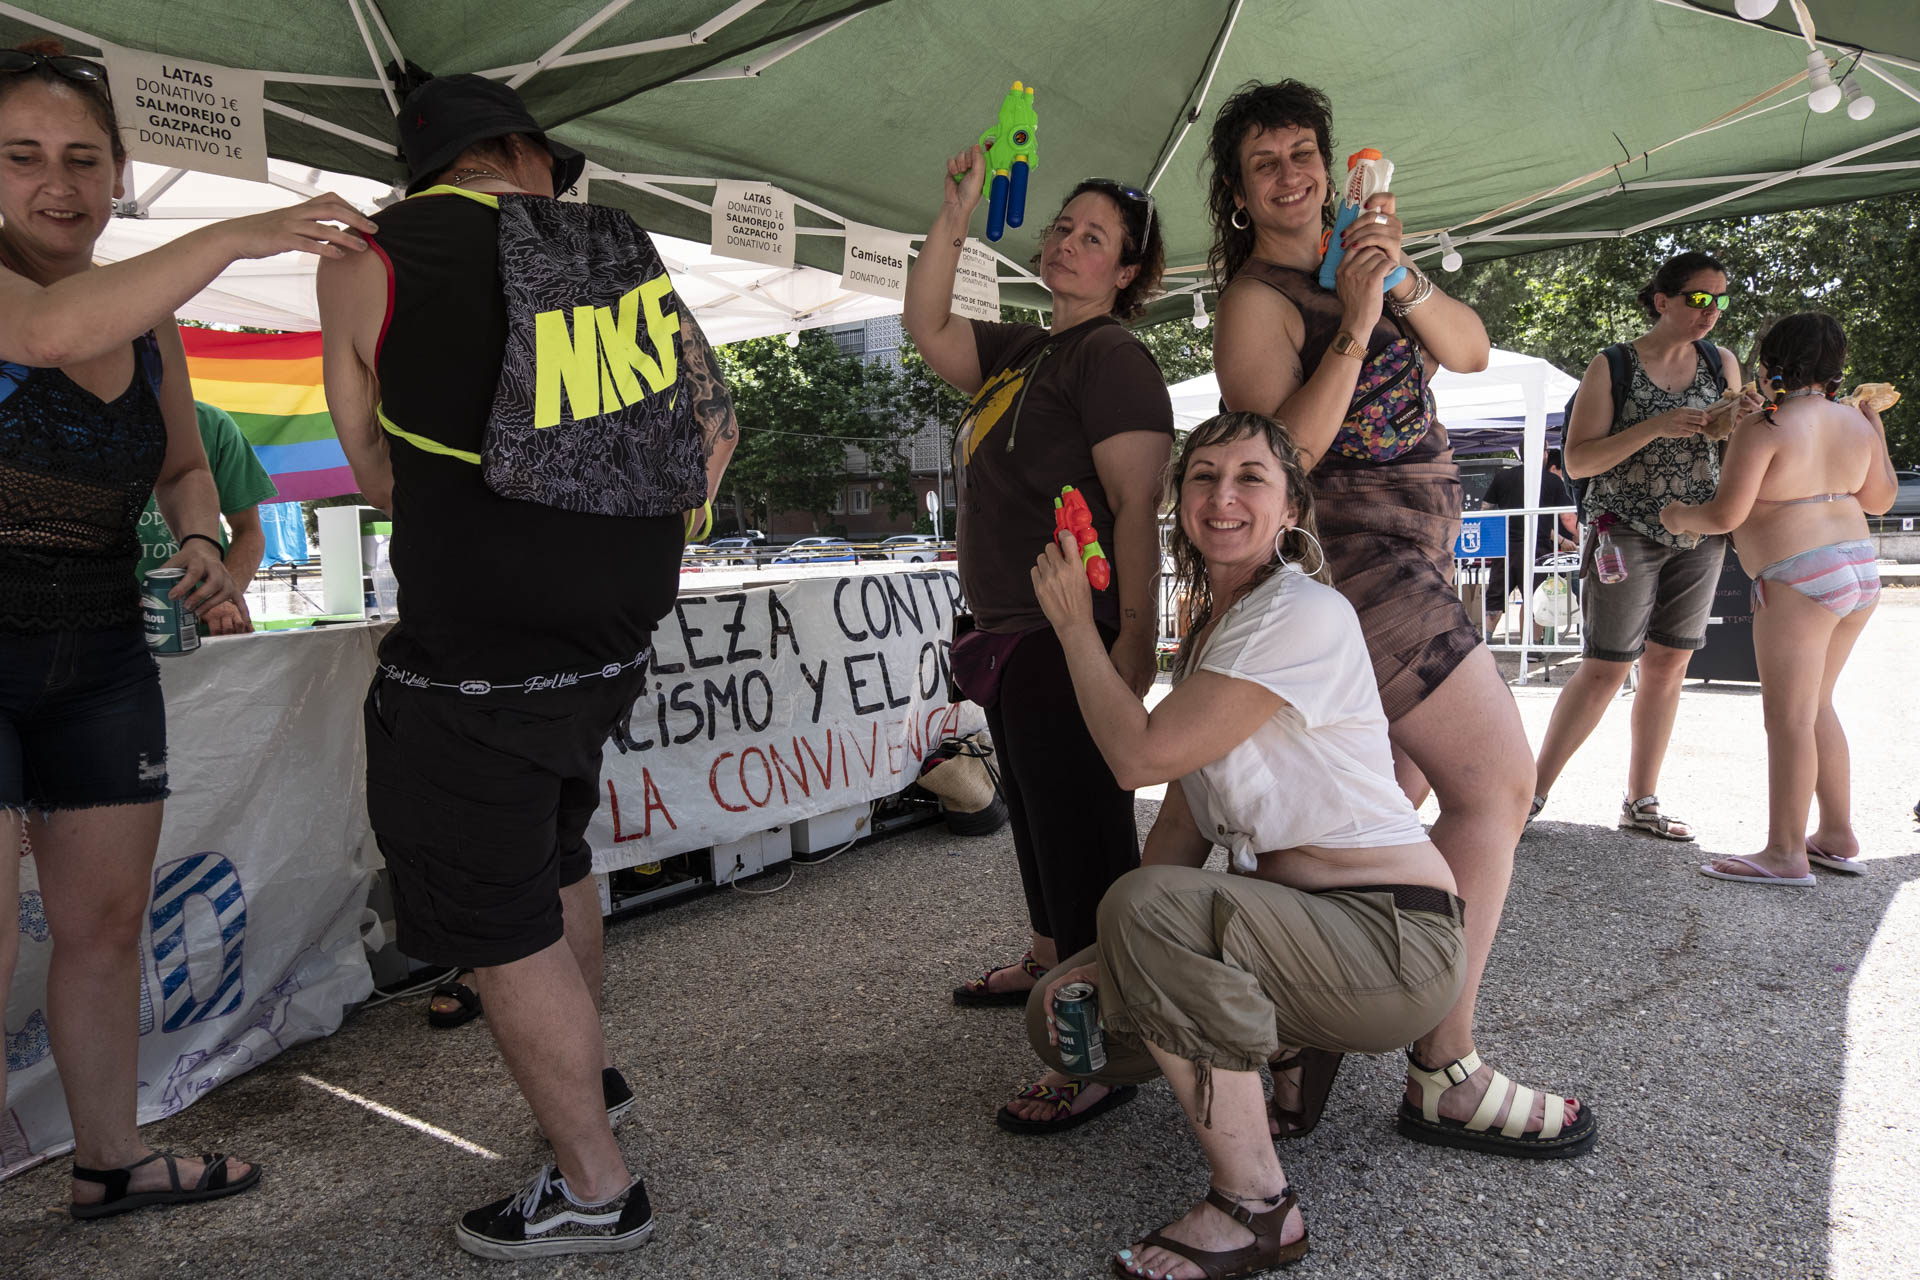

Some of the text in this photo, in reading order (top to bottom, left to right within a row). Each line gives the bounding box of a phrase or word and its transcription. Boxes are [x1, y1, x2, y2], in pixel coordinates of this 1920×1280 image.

[162, 65, 213, 88] LATAS
[136, 77, 239, 111] DONATIVO 1€
[135, 95, 241, 127] SALMOREJO O
[149, 114, 232, 140] GAZPACHO
[139, 129, 243, 160] DONATIVO 1€
[743, 191, 772, 205] LATAS
[727, 201, 784, 220] DONATIVO 1€
[726, 213, 784, 231] SALMOREJO O
[732, 225, 778, 241] GAZPACHO
[727, 235, 782, 253] DONATIVO 1€
[850, 246, 903, 269] Camisetas
[850, 270, 900, 289] DONATIVO 10€
[978, 273, 996, 283] TORTILLA
[977, 299, 998, 310] TORTILLA
[139, 511, 165, 526] OD
[141, 543, 180, 558] TOD
[143, 610, 166, 624] hou
[650, 571, 964, 676] LEZA CONTR
[611, 669, 774, 755] CISMO
[800, 659, 828, 723] Y
[844, 651, 911, 716] EL
[607, 767, 678, 844] LA
